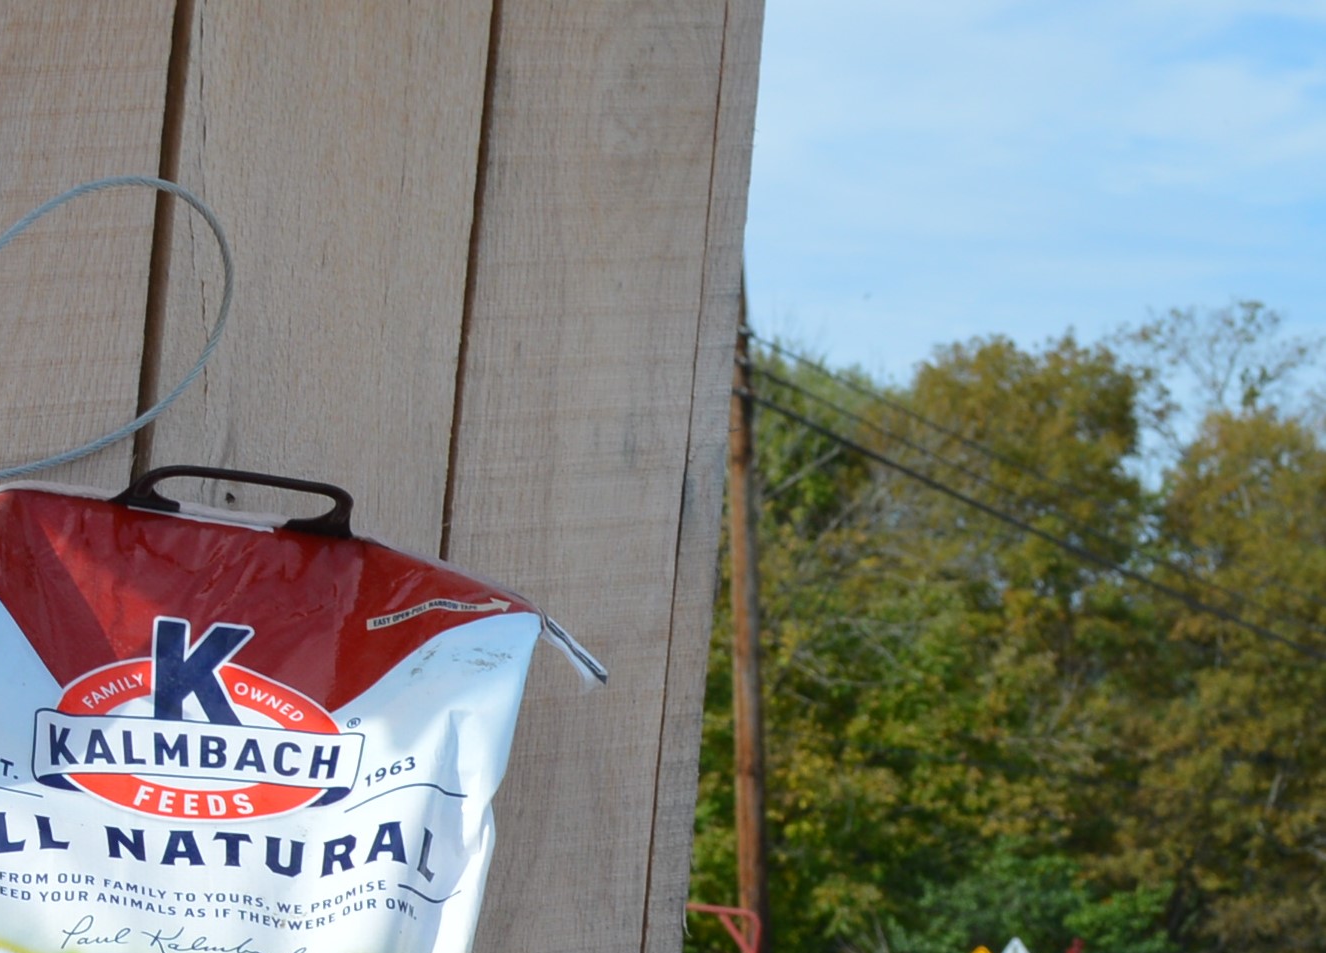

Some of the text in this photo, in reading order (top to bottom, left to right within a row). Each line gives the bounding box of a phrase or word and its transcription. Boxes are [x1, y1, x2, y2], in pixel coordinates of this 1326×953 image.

[373, 616, 391, 627] EASY
[428, 600, 459, 610] NARROW
[154, 619, 252, 725] K
[81, 672, 304, 722] FAMILY OWNED
[49, 723, 341, 780] KALMBACH
[364, 756, 416, 787] 1963
[132, 785, 254, 816] FEEDS
[104, 821, 435, 883] NATURAL
[39, 890, 89, 903] YOUR
[96, 892, 177, 916] ANIMALS
[184, 907, 207, 918] AS
[214, 908, 231, 918] IF
[237, 909, 282, 929] THEY
[287, 913, 336, 931] WERE
[342, 898, 377, 917] OUR
[385, 897, 418, 920] OWN.
[57, 872, 95, 886] OUR
[103, 878, 167, 899] FAMILY
[173, 892, 196, 903] TO
[204, 892, 270, 911] YOURS,
[276, 902, 303, 915] WE
[310, 879, 387, 913] PROMISE
[61, 914, 131, 950] Paul
